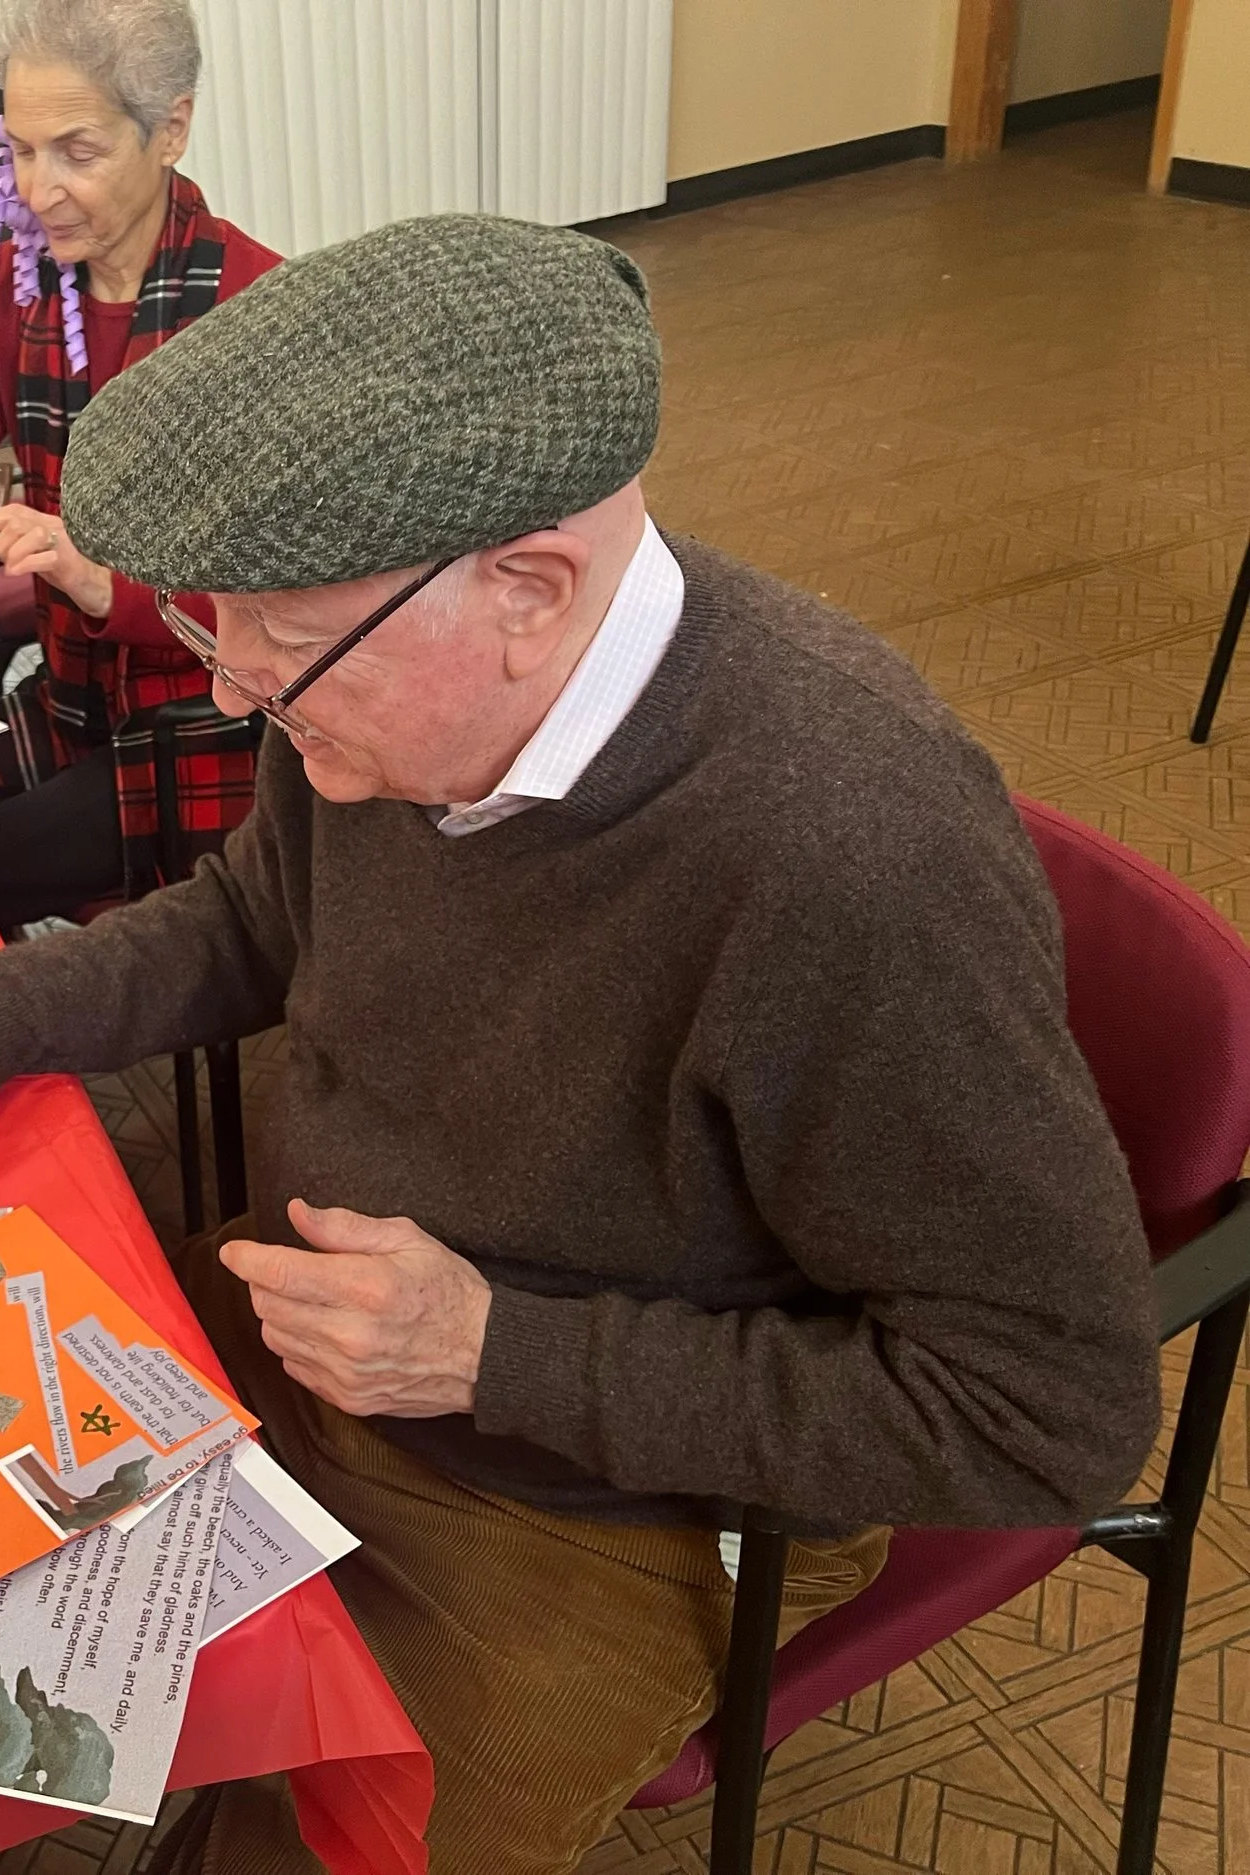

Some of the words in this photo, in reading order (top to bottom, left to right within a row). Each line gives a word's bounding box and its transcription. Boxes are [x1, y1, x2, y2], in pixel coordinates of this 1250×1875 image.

[7, 1285, 22, 1302] will
[26, 1286, 42, 1304] will
[61, 1332, 100, 1367] destined
[89, 1333, 127, 1370] darkness
[126, 1350, 144, 1366] life
[38, 1351, 58, 1374] right
[164, 1362, 190, 1384] deep
[44, 1376, 58, 1391] the
[95, 1366, 115, 1382] not
[120, 1369, 144, 1388] and
[140, 1362, 181, 1400] frolicking
[50, 1391, 60, 1403] in
[110, 1381, 123, 1391] is
[138, 1386, 163, 1406] dust
[185, 1383, 209, 1401] and
[119, 1390, 145, 1413] earth
[49, 1405, 65, 1426] flow
[141, 1412, 160, 1429] the
[158, 1406, 177, 1420] for
[190, 1410, 211, 1428] but
[56, 1427, 71, 1456] rivers
[155, 1426, 179, 1446] that
[59, 1458, 75, 1475] the
[193, 1476, 207, 1501] give
[164, 1489, 184, 1528] almost
[189, 1503, 202, 1519] off
[210, 1495, 225, 1514] the
[156, 1530, 173, 1552] say
[181, 1520, 197, 1548] such
[198, 1516, 221, 1554] beech,
[248, 1526, 283, 1554] asked
[68, 1527, 91, 1571] hrough
[84, 1523, 112, 1584] goodness,
[110, 1555, 127, 1574] the
[152, 1554, 169, 1577] that
[173, 1550, 191, 1579] hints
[195, 1558, 211, 1577] the
[250, 1560, 269, 1580] Yet
[62, 1573, 79, 1593] the
[169, 1581, 182, 1596] of
[219, 1569, 248, 1591] And
[77, 1587, 93, 1611] and
[100, 1576, 121, 1608] hope
[142, 1579, 162, 1606] they
[187, 1579, 203, 1609] oaks
[50, 1595, 70, 1630] world
[96, 1610, 109, 1624] of
[136, 1607, 153, 1639] save
[154, 1596, 178, 1656] gladness.
[181, 1612, 196, 1637] and
[50, 1613, 87, 1696] discernment,
[80, 1625, 104, 1671] myself,
[126, 1641, 144, 1665] me,
[175, 1639, 192, 1661] the
[121, 1669, 137, 1697] and
[162, 1663, 184, 1705] pines,
